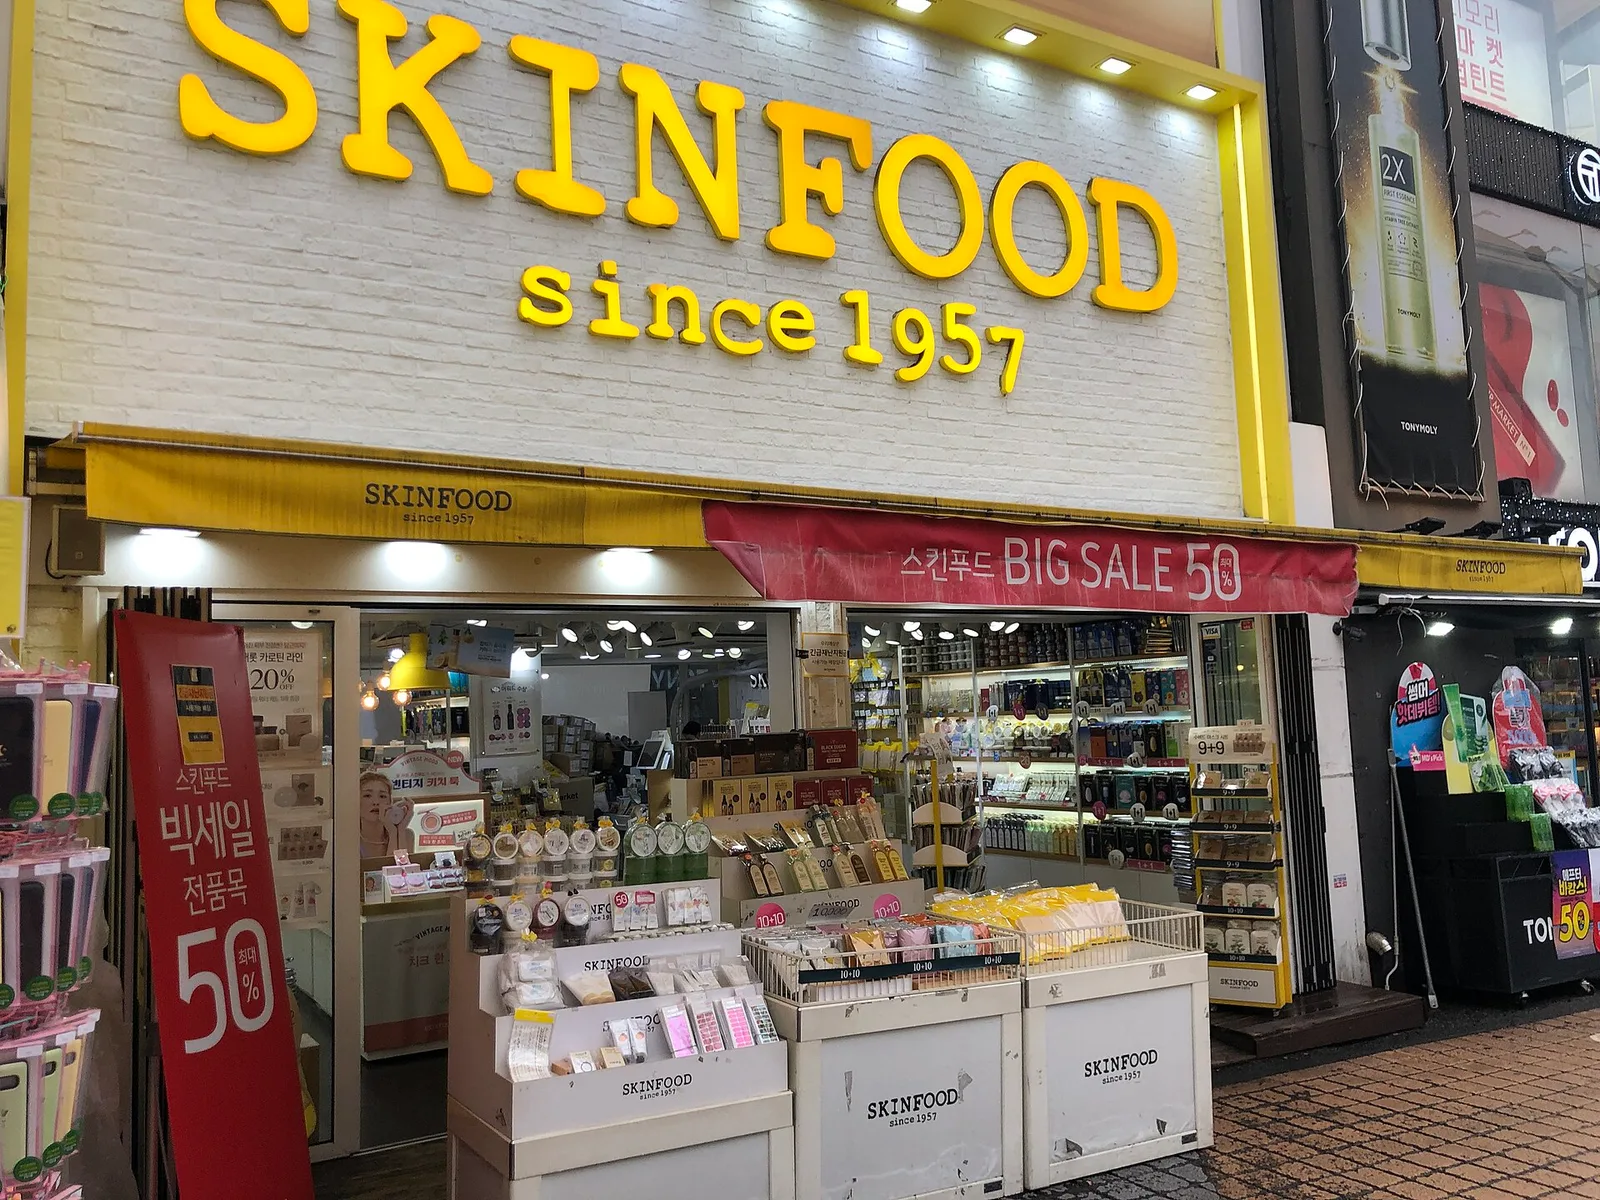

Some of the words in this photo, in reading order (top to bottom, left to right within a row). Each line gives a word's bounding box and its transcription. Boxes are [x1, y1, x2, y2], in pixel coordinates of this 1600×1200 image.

[178, 0, 1179, 312] SKINFOOD
[1381, 153, 1406, 185] 2X
[1397, 308, 1421, 319] TONYMOLY
[519, 259, 817, 356] since
[840, 290, 1025, 396] 1957
[1400, 421, 1438, 435] TONYMOLY
[1492, 400, 1519, 439] MARKET
[365, 483, 512, 511] SKINFOOD
[403, 512, 441, 523] since
[445, 512, 474, 525] 1957
[900, 547, 995, 582] 스킨푸드
[1004, 537, 1070, 585] BIG
[1080, 541, 1174, 592] SALE
[1185, 543, 1242, 601] 50
[1455, 559, 1506, 574] SKINFOOD
[259, 652, 284, 663] 카로틴
[286, 652, 303, 663] 라인
[1408, 680, 1428, 701] 썸머
[1197, 740, 1225, 755] 9+9
[176, 767, 232, 794] 스킨푸드
[160, 799, 256, 865] 빅세일
[183, 868, 247, 916] 전품목
[875, 899, 901, 919] 10+10
[757, 912, 786, 928] 10+10
[1559, 900, 1591, 943] 50
[414, 925, 444, 940] VINTAGE
[238, 946, 257, 966] 최대
[913, 961, 933, 971] 10+10
[985, 956, 1002, 965] 10+10
[840, 969, 861, 979] 10+10
[1220, 978, 1259, 988] SKINFOOD
[176, 917, 275, 1055] 50
[242, 971, 260, 1003] %
[1084, 1049, 1158, 1078] SKINFOOD
[622, 1073, 693, 1096] SKINFOOD
[1102, 1073, 1123, 1085] since
[1124, 1070, 1141, 1081] 1957
[639, 1090, 660, 1100] since
[660, 1088, 676, 1097] 1957
[867, 1088, 959, 1120] SKINFOOD
[889, 1115, 915, 1127] since
[916, 1112, 937, 1124] 1957
